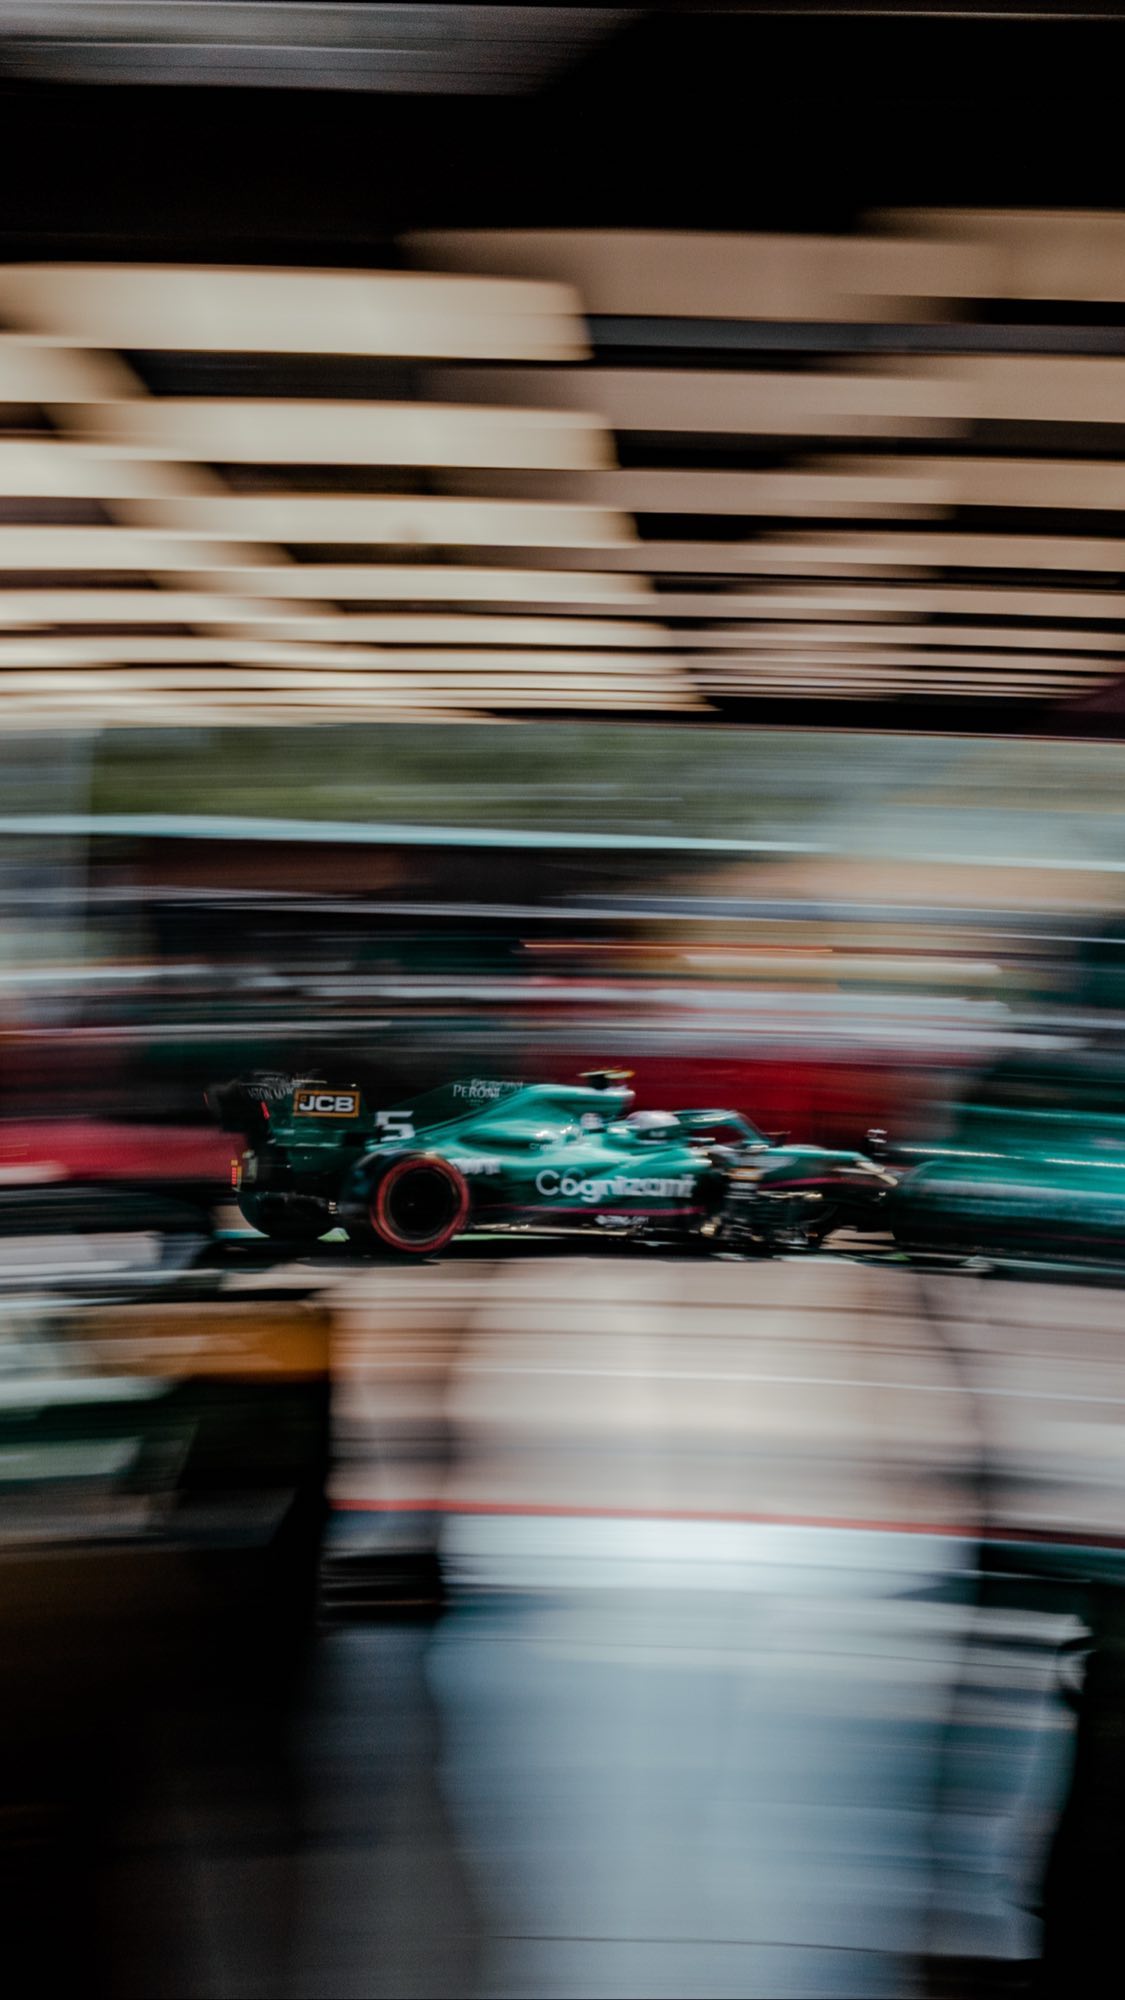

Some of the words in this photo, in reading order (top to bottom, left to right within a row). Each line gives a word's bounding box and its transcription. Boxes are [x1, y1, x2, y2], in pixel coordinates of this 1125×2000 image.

[299, 1095, 355, 1113] JCB
[374, 1110, 416, 1142] 5
[535, 1168, 697, 1204] Cognizant
